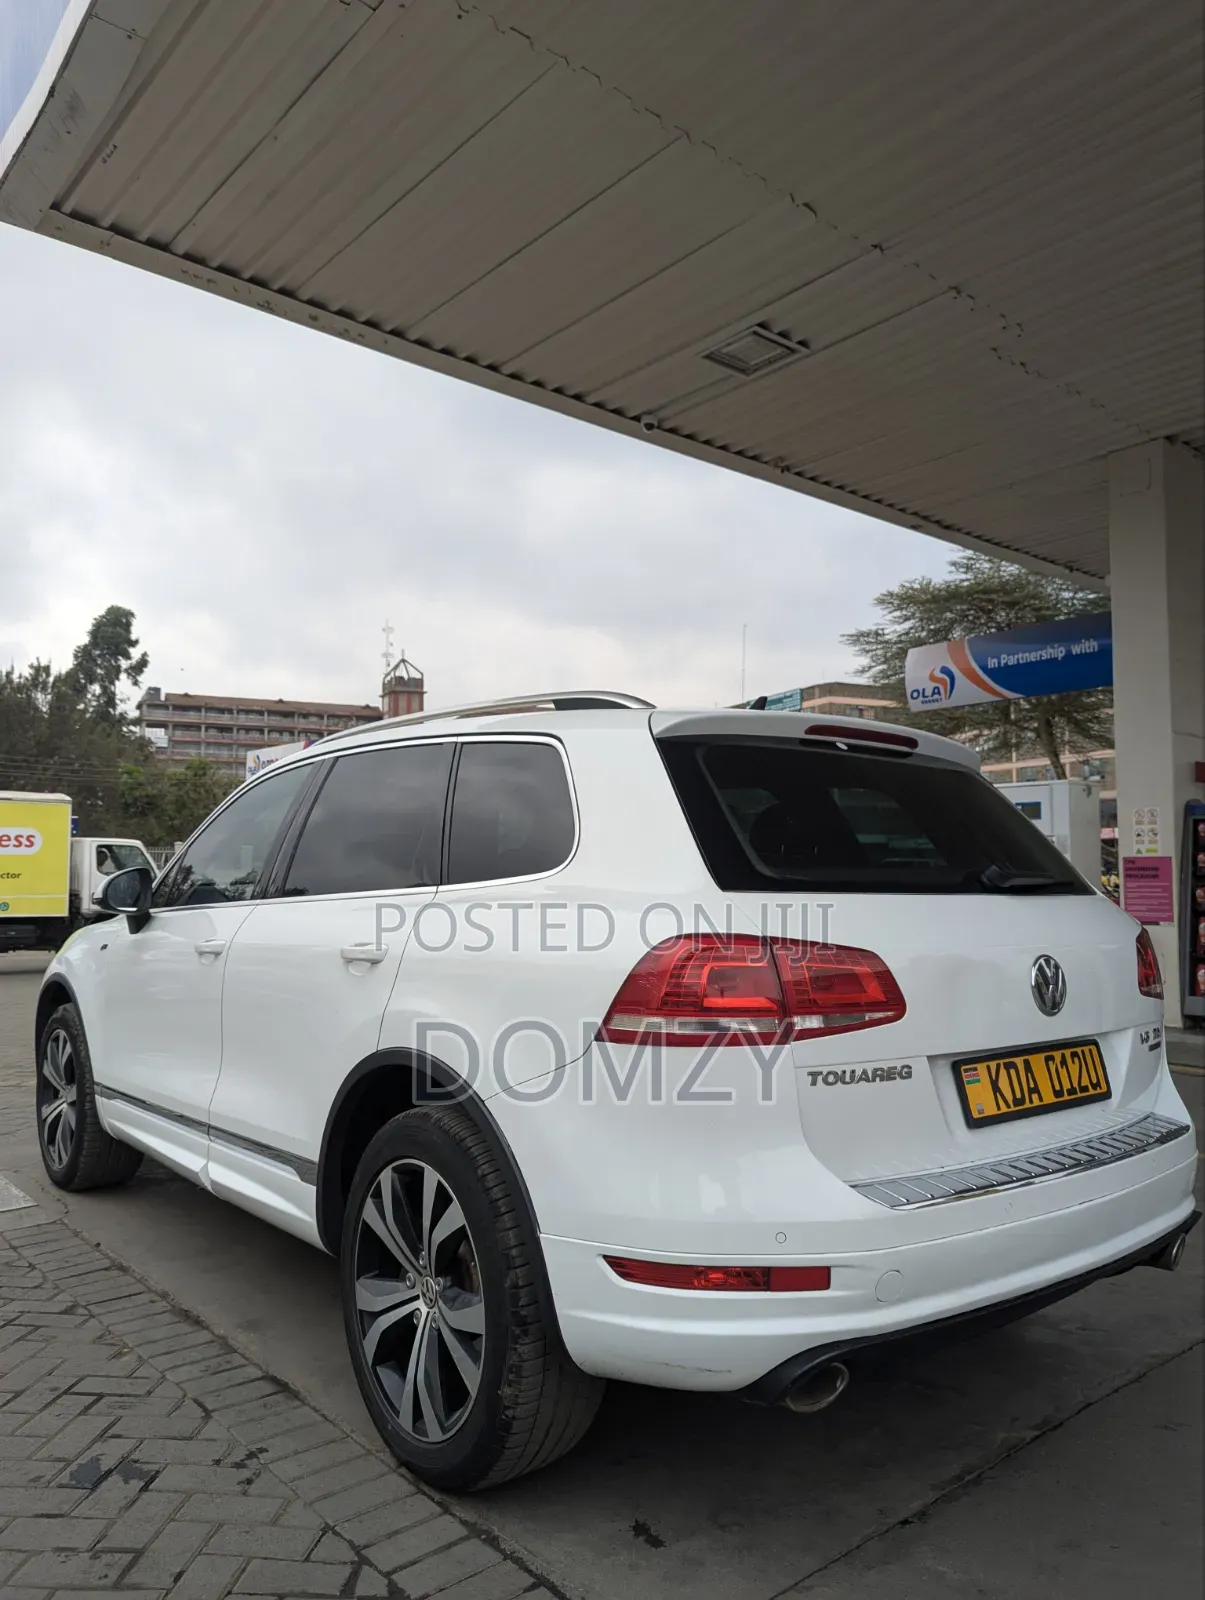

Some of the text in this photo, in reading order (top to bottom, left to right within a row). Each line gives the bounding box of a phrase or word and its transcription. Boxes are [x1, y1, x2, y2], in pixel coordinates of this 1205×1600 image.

[988, 639, 1098, 669] In Partnership with
[910, 686, 941, 700] OLA
[0, 833, 36, 848] ess
[807, 1064, 912, 1086] TOUAREG
[986, 1048, 1102, 1111] KDA 012U
